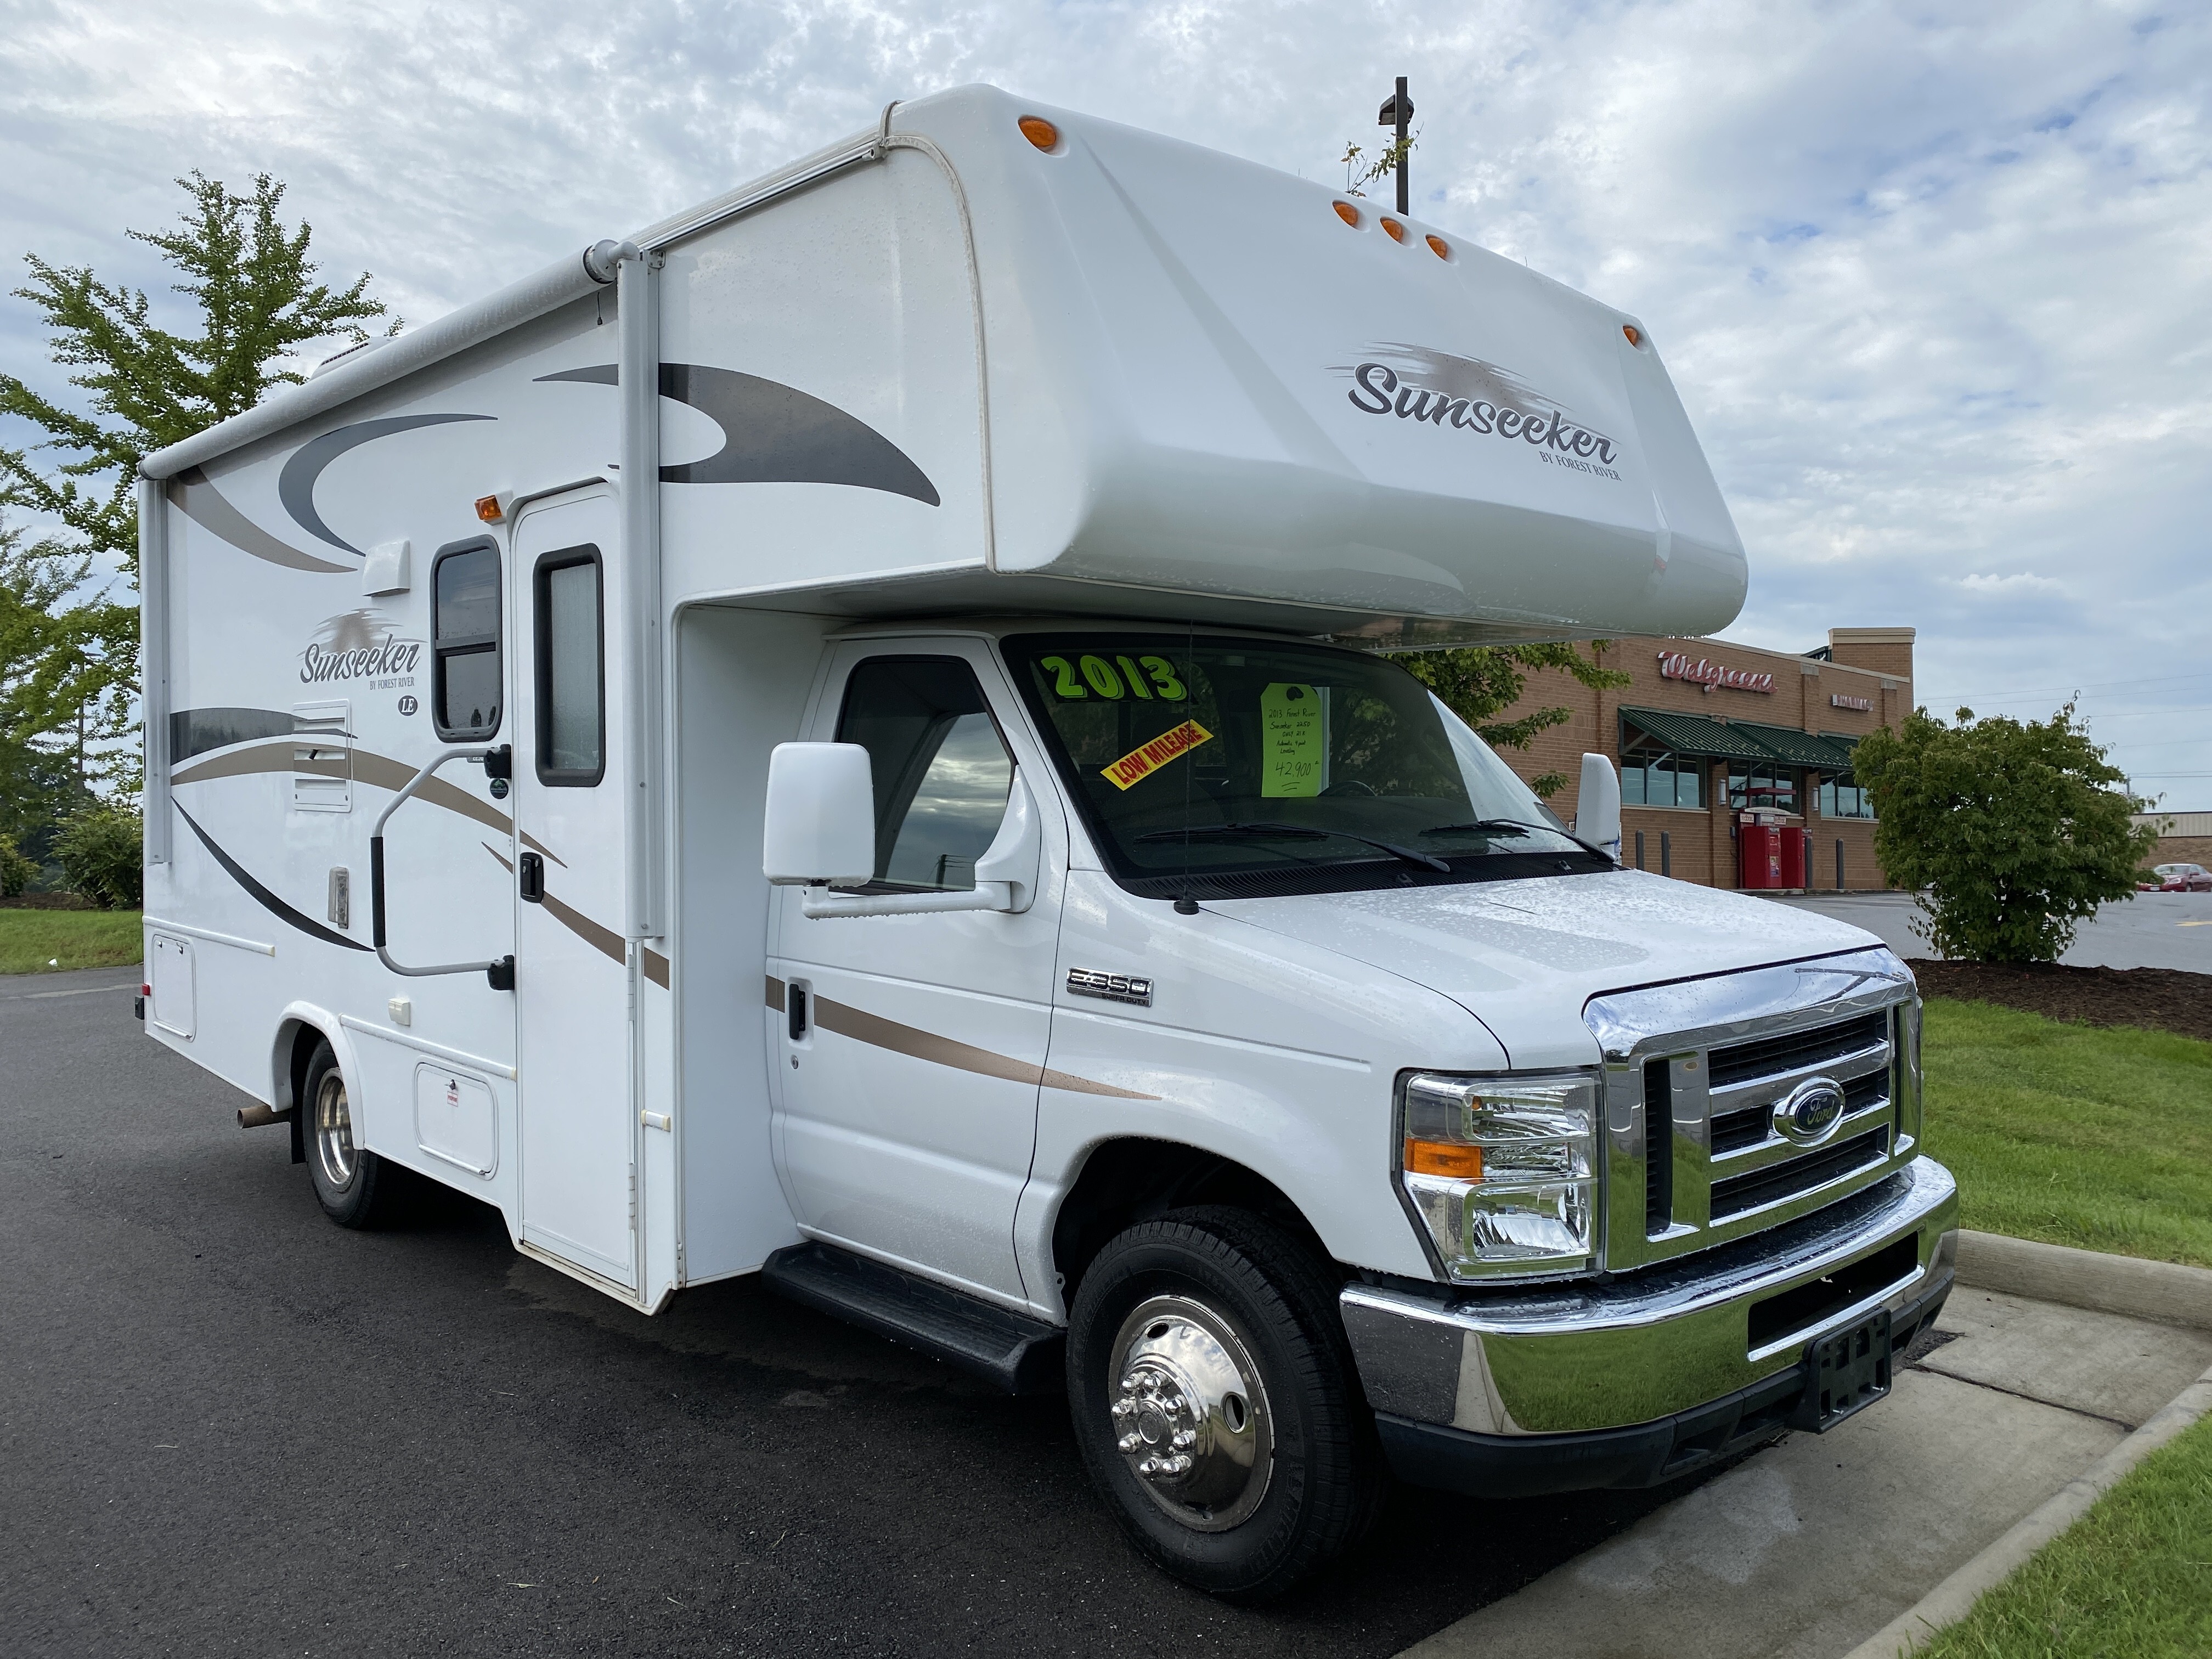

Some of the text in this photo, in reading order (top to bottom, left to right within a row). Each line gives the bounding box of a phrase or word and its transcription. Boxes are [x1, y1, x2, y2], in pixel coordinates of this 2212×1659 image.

[1348, 363, 1617, 465] Sunseeker
[1539, 451, 1622, 481] BY FOREST RIVER
[300, 634, 420, 683] Sunseeker
[1658, 651, 1779, 693] Walgreens
[370, 677, 414, 690] BY FOREST RIVER
[1041, 655, 1187, 701] 2013
[401, 698, 414, 712] LE
[1269, 708, 1316, 718] 2013 Forest River
[1111, 724, 1206, 785] LOW MILEAGE
[1276, 761, 1311, 777] 42,900
[1101, 993, 1125, 1002] SUPER
[1807, 1096, 1835, 1125] Ford
